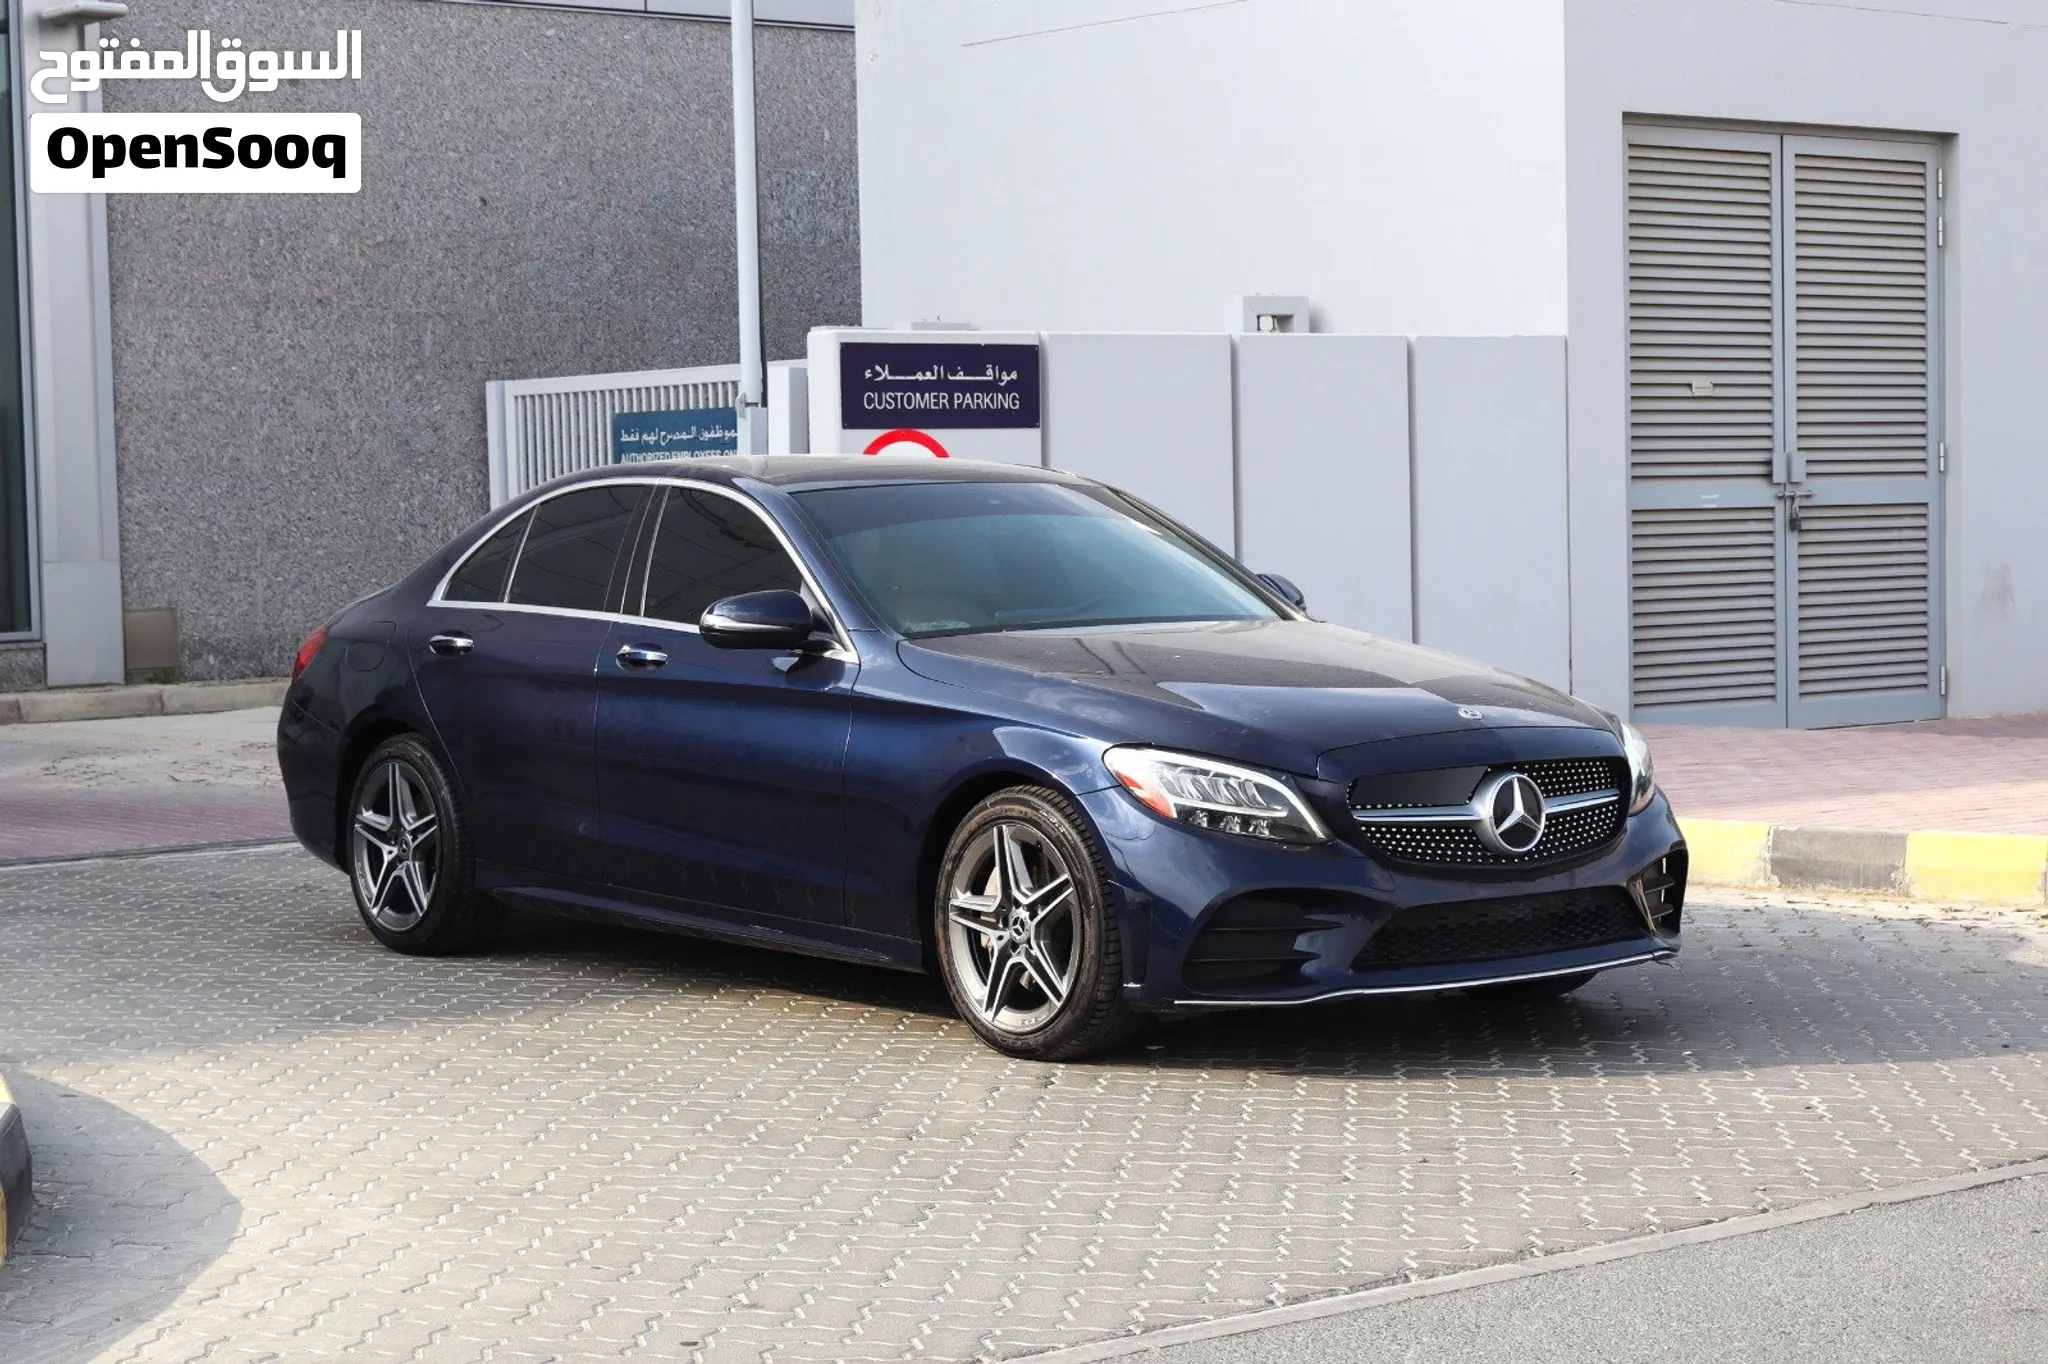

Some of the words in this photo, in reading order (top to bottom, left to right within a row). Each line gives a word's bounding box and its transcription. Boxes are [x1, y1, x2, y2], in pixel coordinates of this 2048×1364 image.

[864, 364, 944, 381] العملاء
[947, 364, 1018, 386] مواقف
[863, 391, 949, 410] CUSTOMER
[954, 392, 1020, 410] PARKING
[620, 427, 639, 442] فقط
[641, 427, 659, 445] لهم
[621, 451, 671, 465] AUTHORIZED
